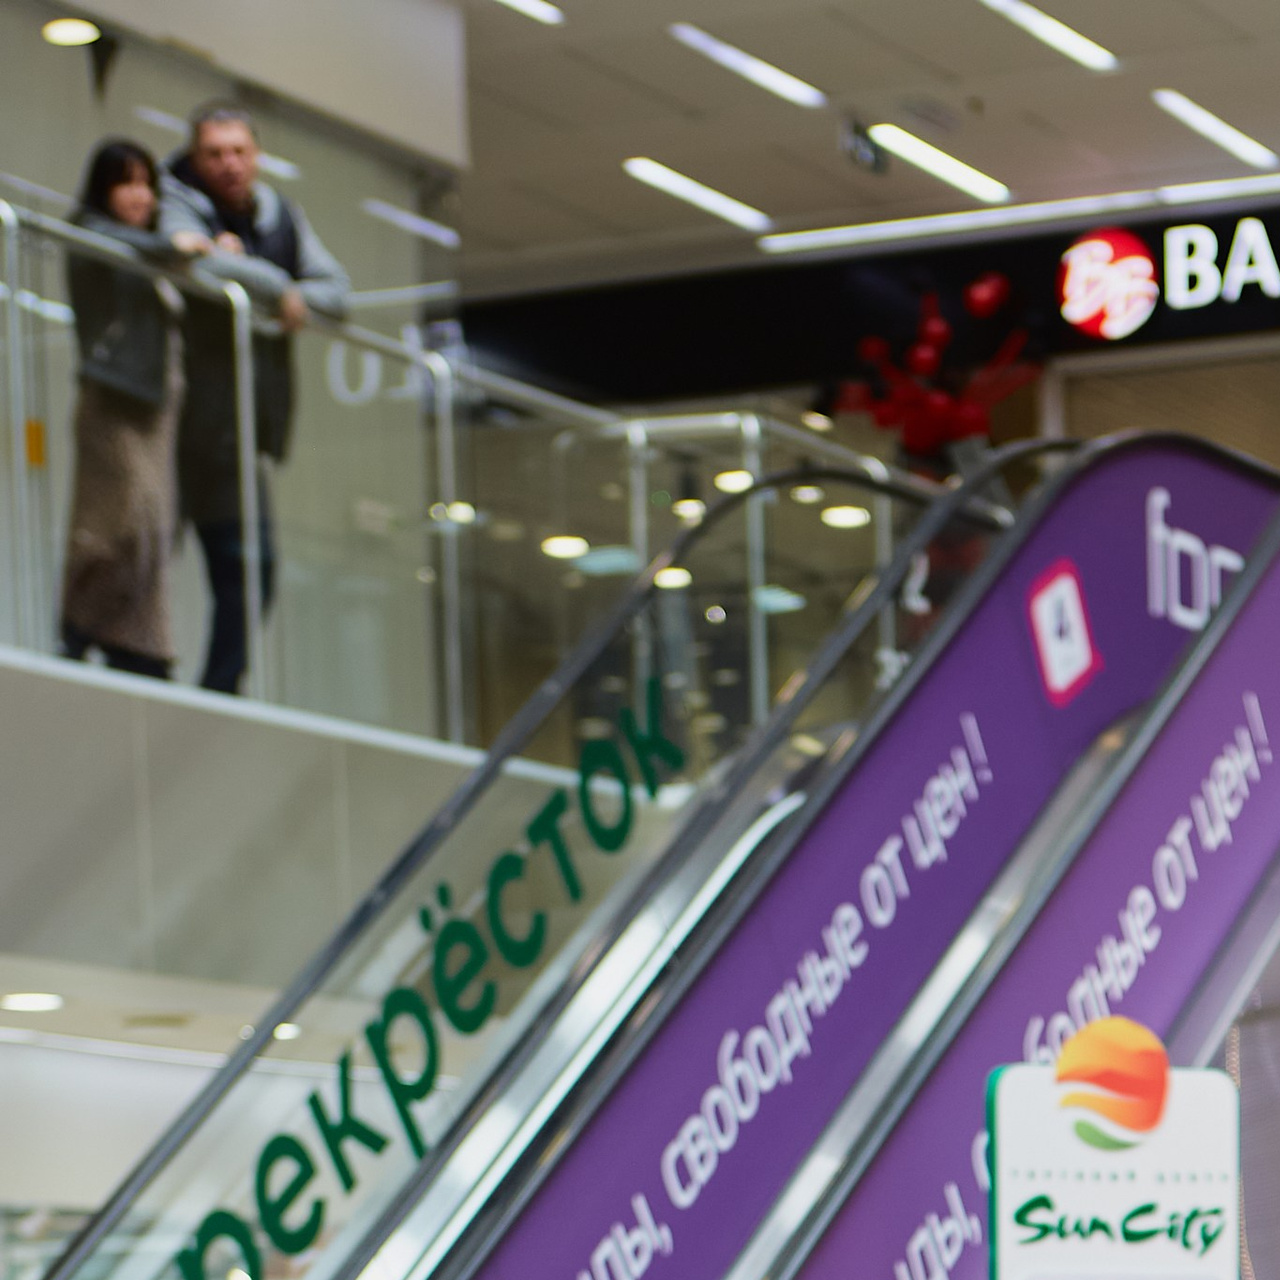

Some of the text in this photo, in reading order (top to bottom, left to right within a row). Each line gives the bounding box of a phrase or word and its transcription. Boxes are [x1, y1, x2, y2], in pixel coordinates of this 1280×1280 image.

[660, 902, 869, 1210] свободные
[860, 836, 910, 928] от
[901, 711, 993, 869] цен!
[1152, 816, 1200, 911] от
[1189, 691, 1273, 852] цен!
